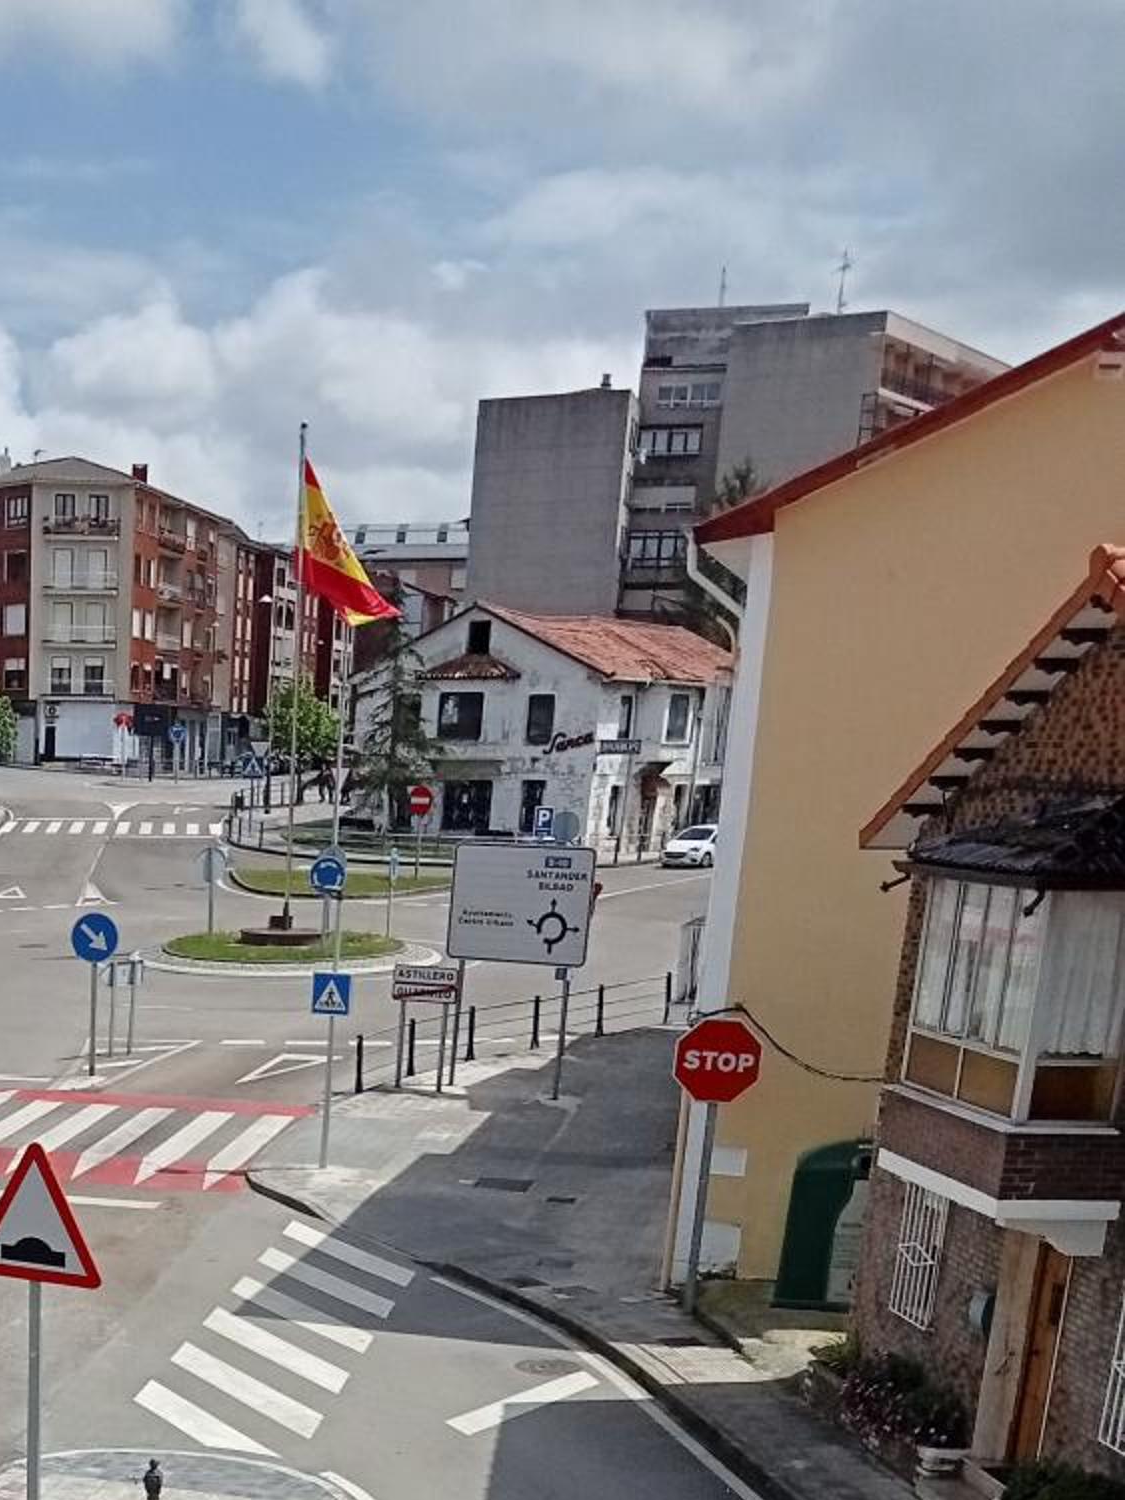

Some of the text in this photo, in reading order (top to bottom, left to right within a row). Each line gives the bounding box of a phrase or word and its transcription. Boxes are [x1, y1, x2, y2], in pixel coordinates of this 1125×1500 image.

[526, 869, 588, 881] SANTANDER
[397, 969, 454, 981] ASTILLERO
[682, 1049, 755, 1073] STOP
